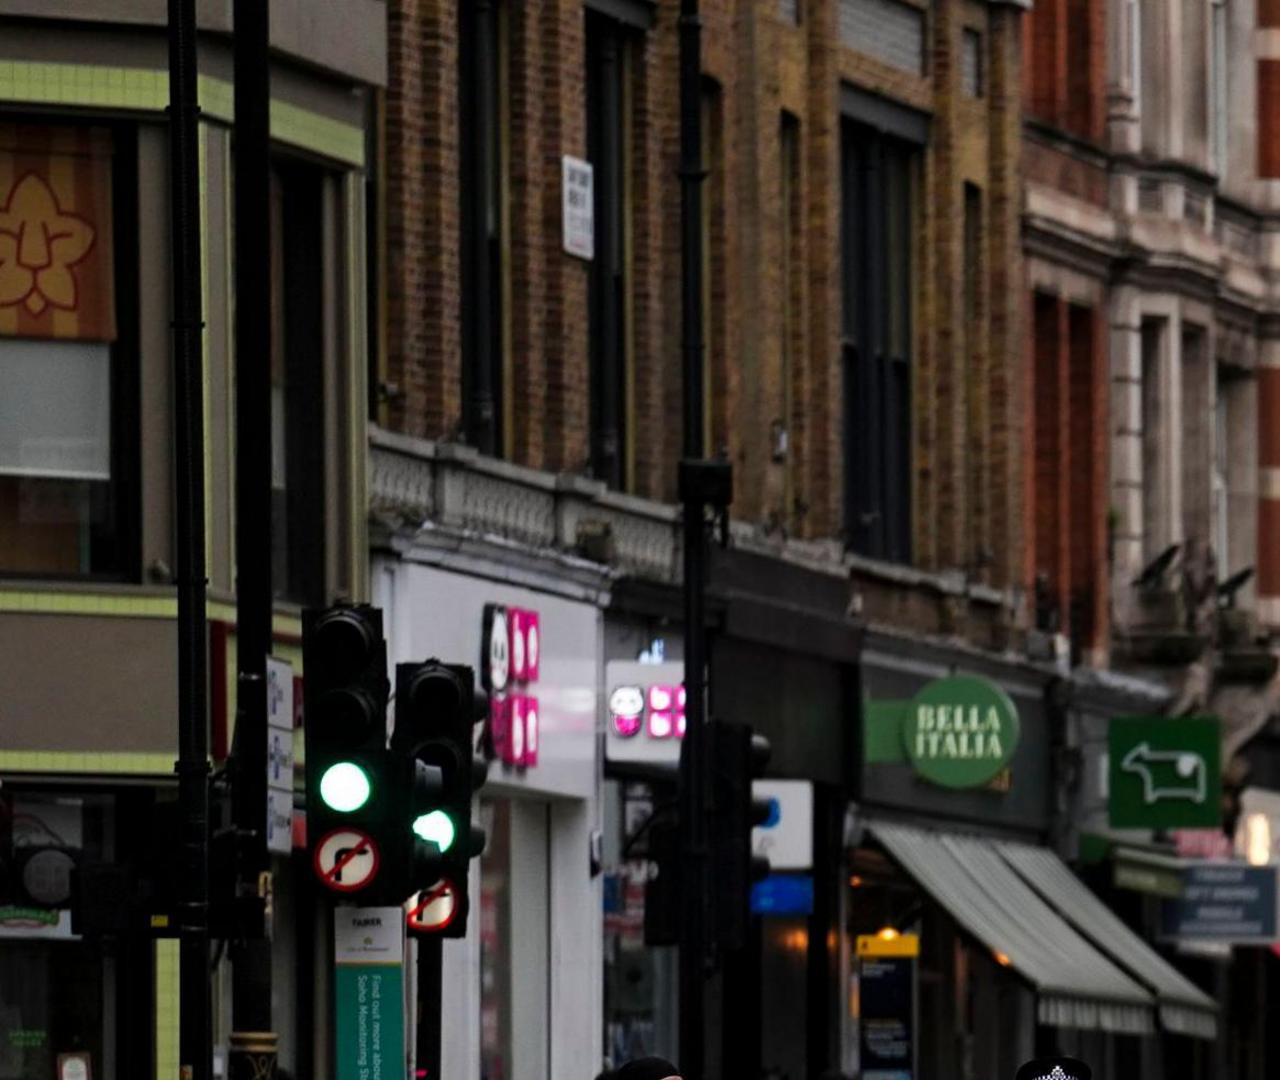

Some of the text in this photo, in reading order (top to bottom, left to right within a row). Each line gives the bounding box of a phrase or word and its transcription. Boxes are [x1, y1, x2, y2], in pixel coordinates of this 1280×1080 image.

[917, 704, 1001, 732] BELLA
[915, 731, 1003, 759] ITALIA
[357, 975, 367, 1003] Soho
[371, 975, 382, 999] Find
[371, 1002, 381, 1020] out
[357, 1006, 369, 1066] Monitoring
[372, 1022, 381, 1051] more
